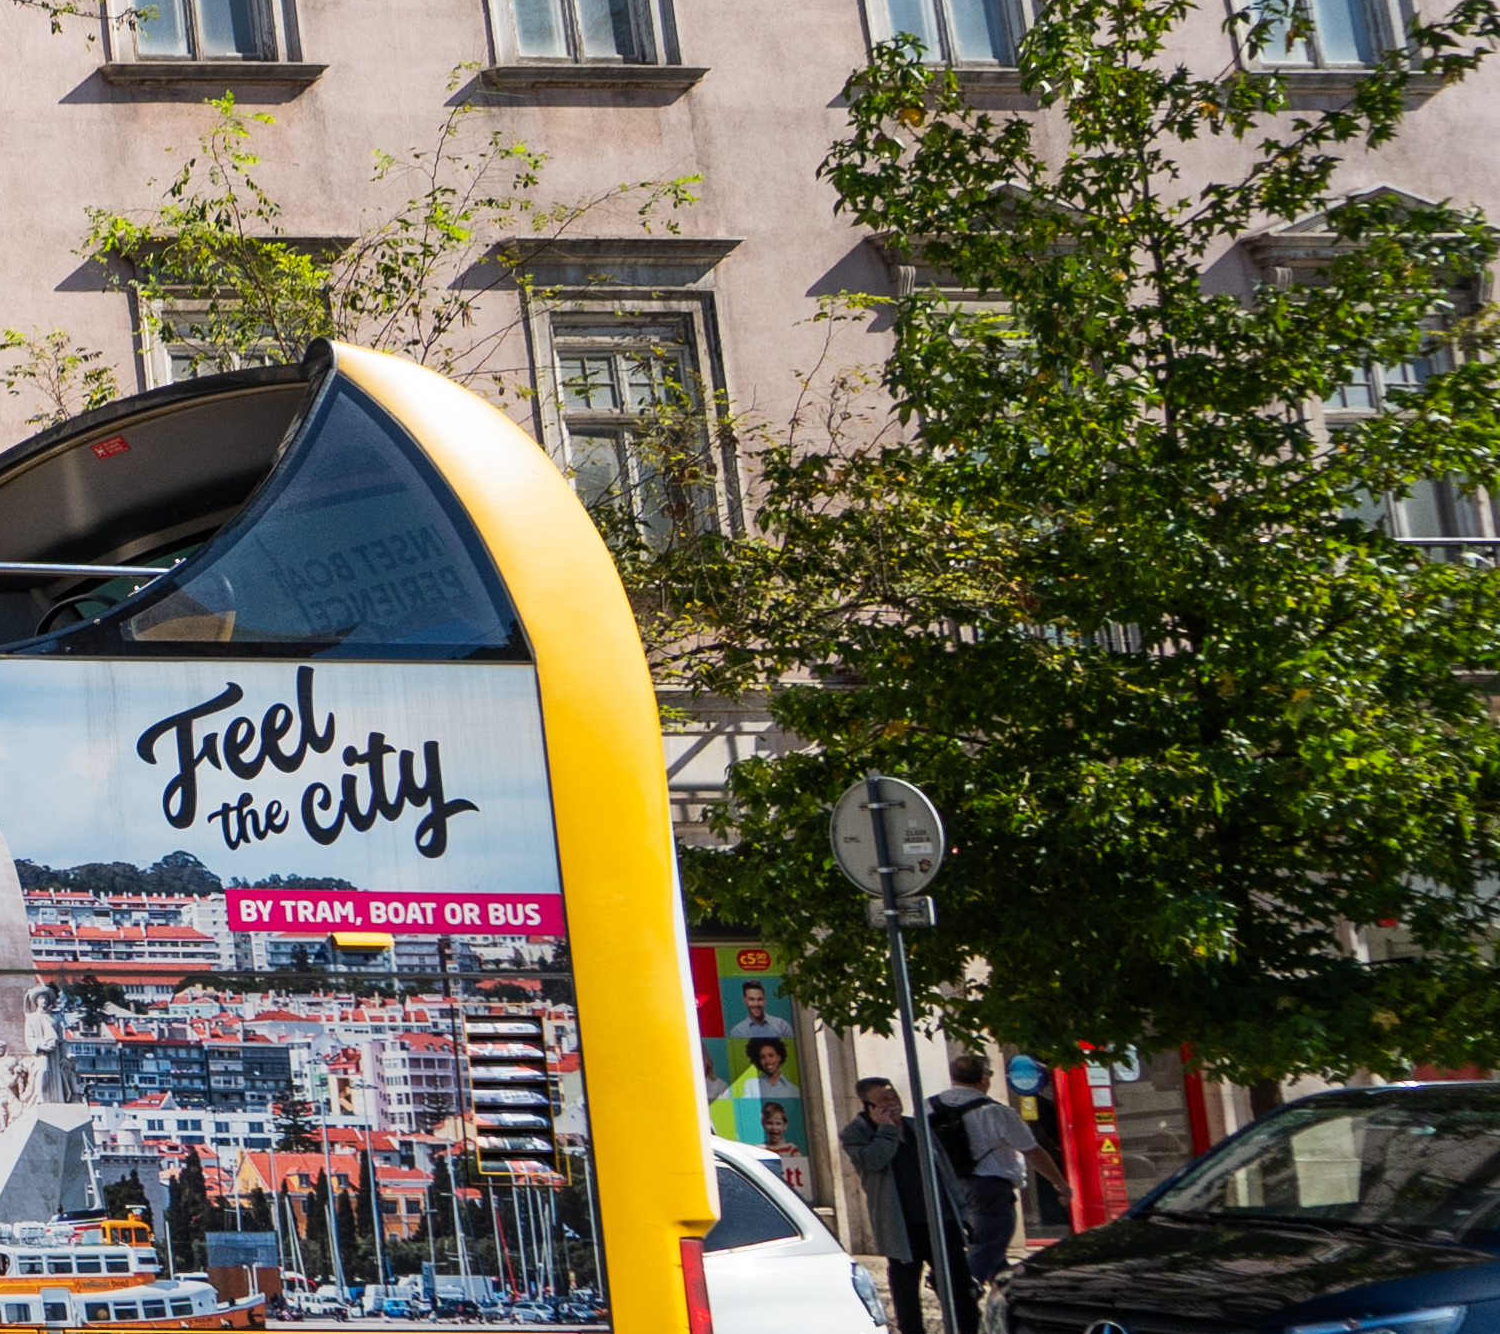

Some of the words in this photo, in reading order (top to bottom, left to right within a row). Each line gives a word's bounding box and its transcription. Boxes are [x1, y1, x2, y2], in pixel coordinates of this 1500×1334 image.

[136, 665, 334, 829] Feel
[207, 792, 289, 850] the
[300, 732, 480, 859] city
[240, 900, 271, 924] BY
[281, 900, 363, 927] TRAM,
[370, 901, 437, 925] BOAT
[444, 902, 481, 926] OR
[488, 903, 541, 926] BUS
